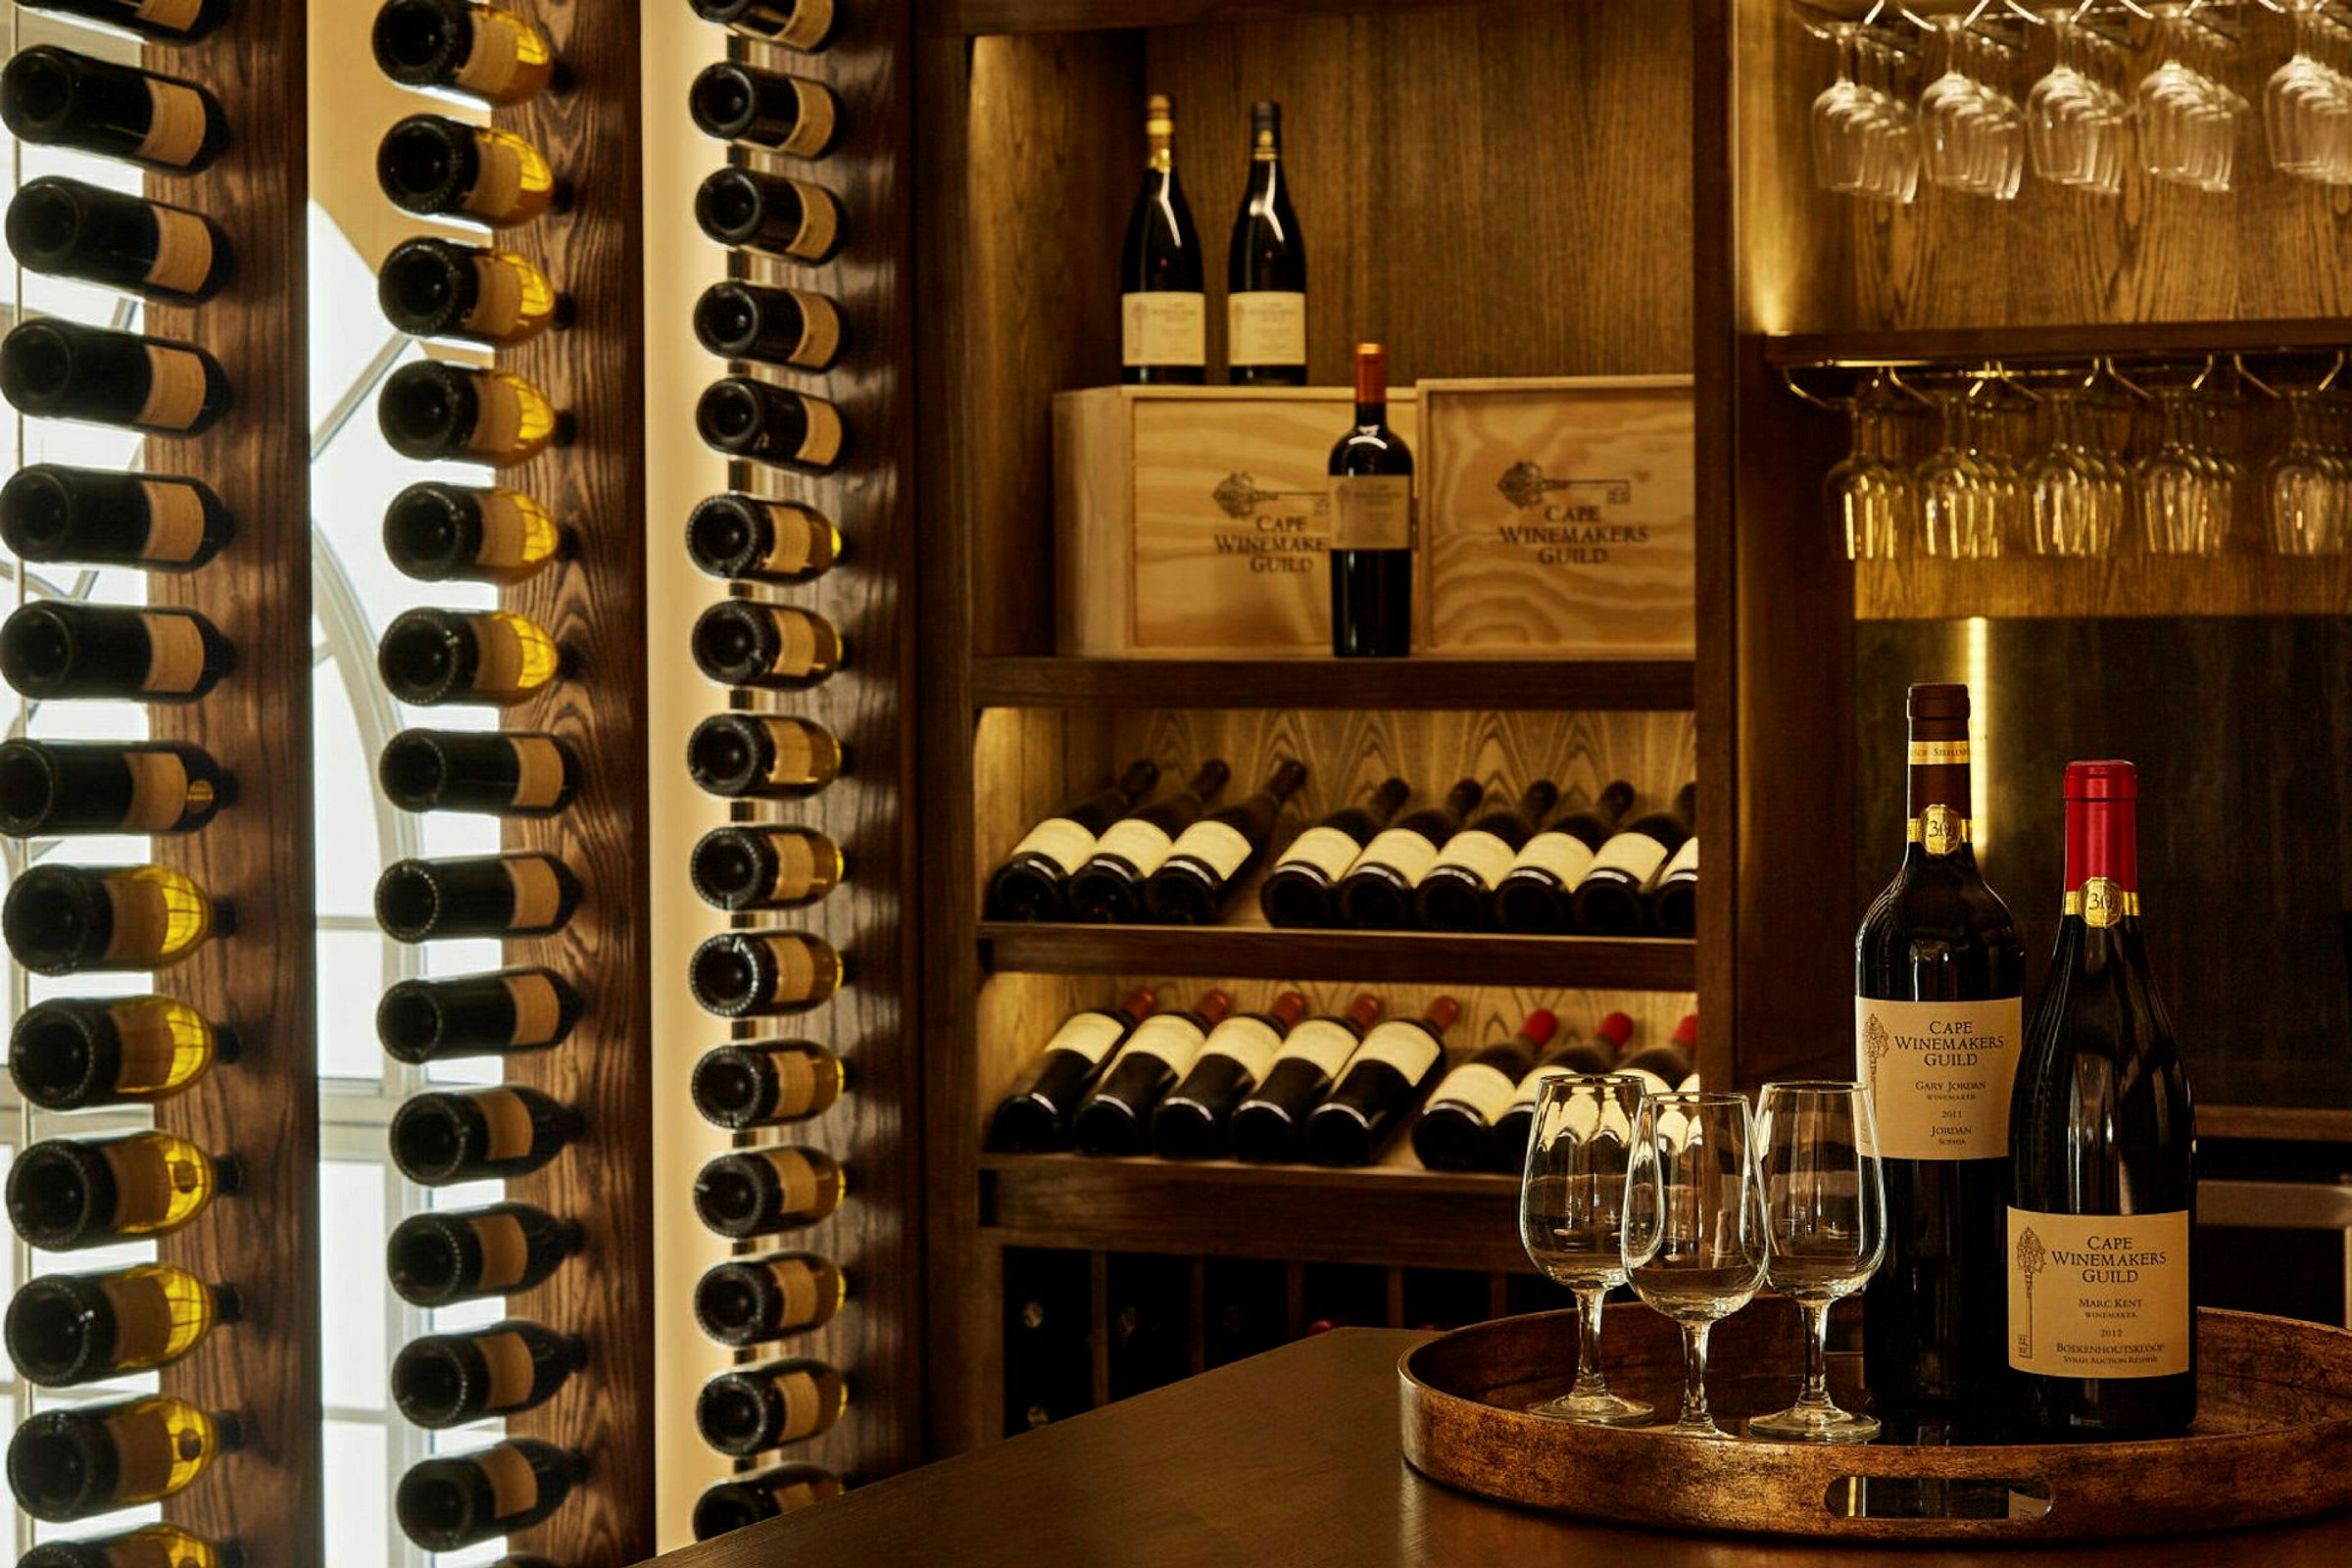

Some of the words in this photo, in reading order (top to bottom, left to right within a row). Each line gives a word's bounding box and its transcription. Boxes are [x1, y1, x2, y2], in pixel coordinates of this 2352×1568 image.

[1544, 505, 1600, 522] CAPE
[1256, 515, 1306, 532] CAPE
[1499, 525, 1648, 544] WINEMAKERS
[1214, 534, 1325, 554] WINEMAKE
[1538, 548, 1608, 564] GUILD
[1250, 556, 1313, 573] GUILD
[2088, 893, 2114, 909] 30
[1930, 1020, 1973, 1034] CAPE
[1894, 1036, 2004, 1051] WINEMAKERS
[1924, 1054, 1978, 1066] GUILD
[1915, 1081, 1943, 1090] GARY
[1947, 1081, 1986, 1093] JORDAN
[1930, 1126, 1972, 1137] JORDAN
[2087, 1236, 2132, 1250] CAPE
[2052, 1250, 2167, 1267] WINEMAKERS
[2082, 1270, 2138, 1283] GUILD
[2079, 1298, 2113, 1307] MARC
[2114, 1298, 2142, 1308] KENT
[2100, 1329, 2123, 1338] 2012
